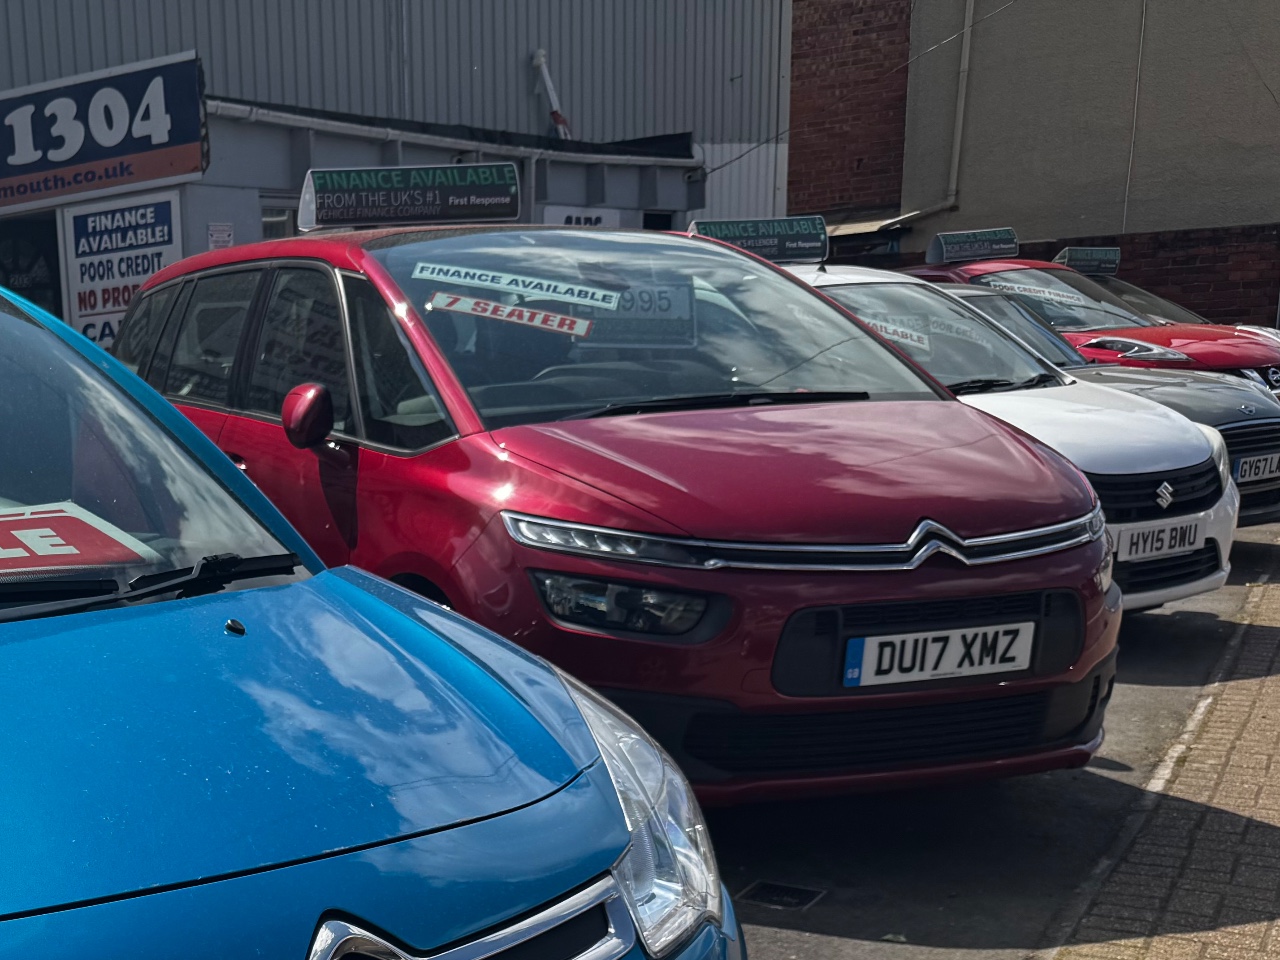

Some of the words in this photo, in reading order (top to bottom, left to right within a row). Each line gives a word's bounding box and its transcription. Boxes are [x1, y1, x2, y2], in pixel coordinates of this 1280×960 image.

[4, 75, 172, 166] 1304
[313, 170, 403, 190] FINANCE
[409, 166, 517, 187] AVAILABLE
[316, 193, 356, 209] FROM
[359, 192, 387, 207] THE
[426, 190, 442, 205] #1
[448, 196, 468, 206] First
[470, 196, 511, 206] Response
[87, 207, 155, 233] FINANCE
[316, 209, 356, 220] VEHICLE
[357, 208, 397, 219] FINANCE
[397, 206, 442, 218] COMPANY
[78, 225, 169, 255] AVAILABLE!
[700, 223, 756, 238] FINANCE
[759, 220, 825, 236] AVAILABLE
[80, 260, 114, 284] POOR
[418, 265, 504, 285] FINANCE
[507, 277, 614, 304] AVAILABLE
[77, 289, 97, 312] NO
[620, 290, 671, 312] 995
[444, 295, 462, 308] 7
[471, 300, 577, 333] SEATER
[82, 320, 122, 343] CA
[867, 322, 925, 345] AILABLE
[1240, 457, 1269, 479] GY67
[1128, 529, 1166, 556] HY15
[1168, 523, 1198, 550] BWU
[875, 635, 950, 677] DU17
[957, 628, 1020, 669] XMZ
